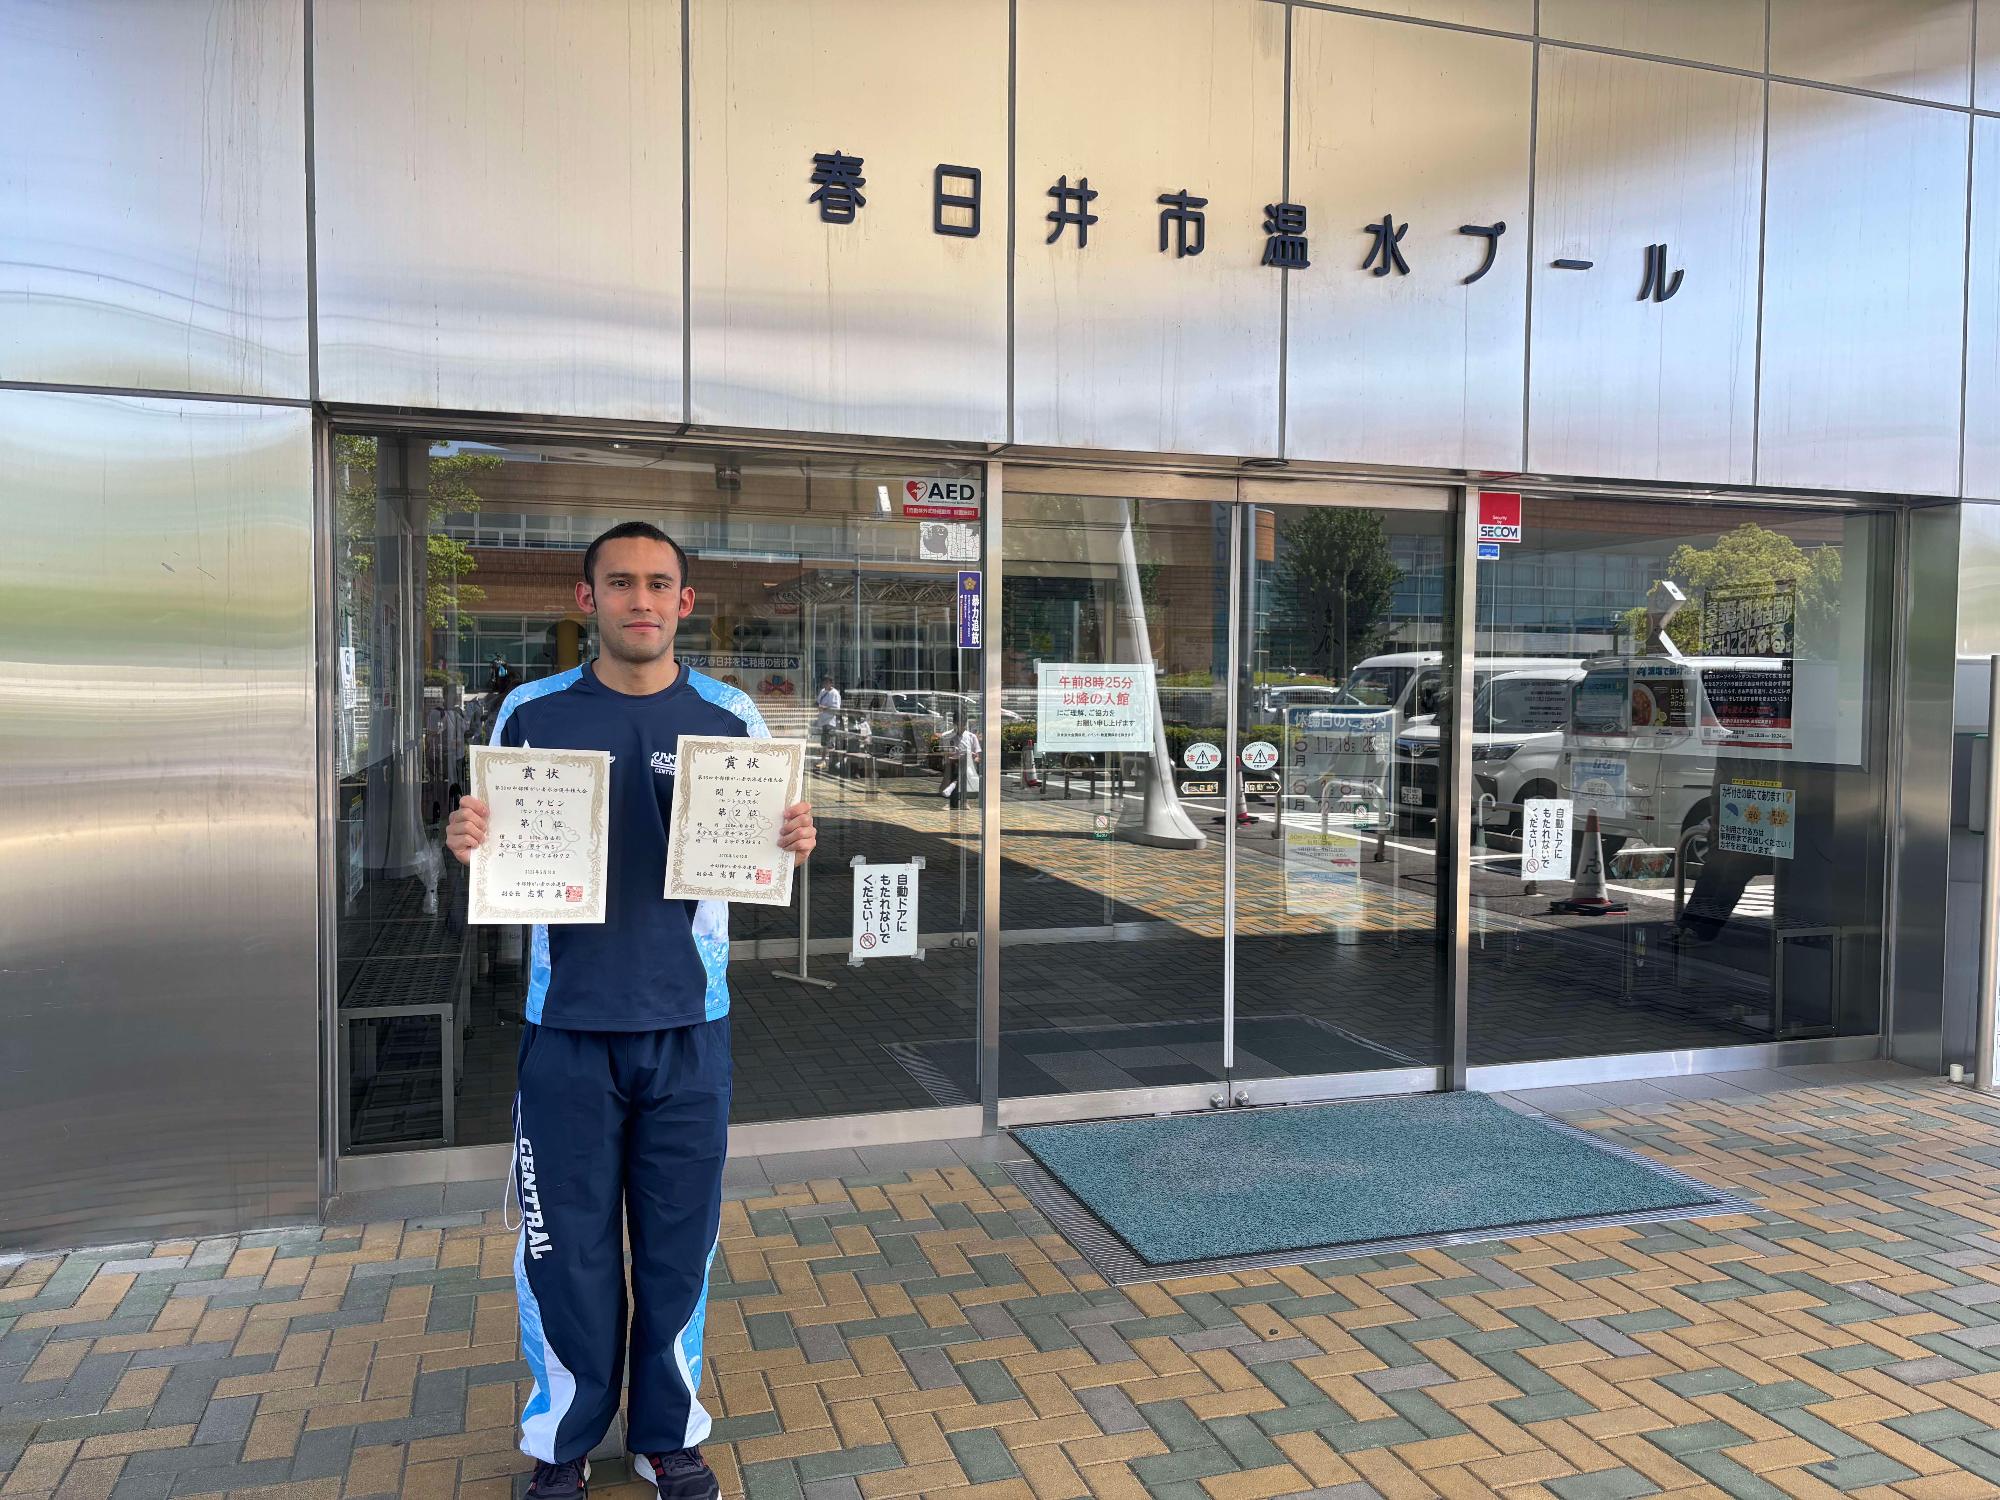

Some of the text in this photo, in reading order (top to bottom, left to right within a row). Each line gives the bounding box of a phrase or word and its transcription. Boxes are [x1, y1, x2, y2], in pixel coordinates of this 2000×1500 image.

[809, 149, 1684, 303] 春日井市温水プール
[928, 482, 975, 501] AED
[1480, 526, 1518, 538] SECOM
[1058, 675, 1134, 690] 午前8時25分
[1062, 691, 1130, 706] 以降の入館
[654, 767, 676, 776] CENTRA
[1554, 807, 1565, 859] 自動ドアに
[879, 874, 891, 944] もたれないで
[896, 873, 908, 933] 自動ドアに
[519, 1137, 553, 1260] CENTRAL
